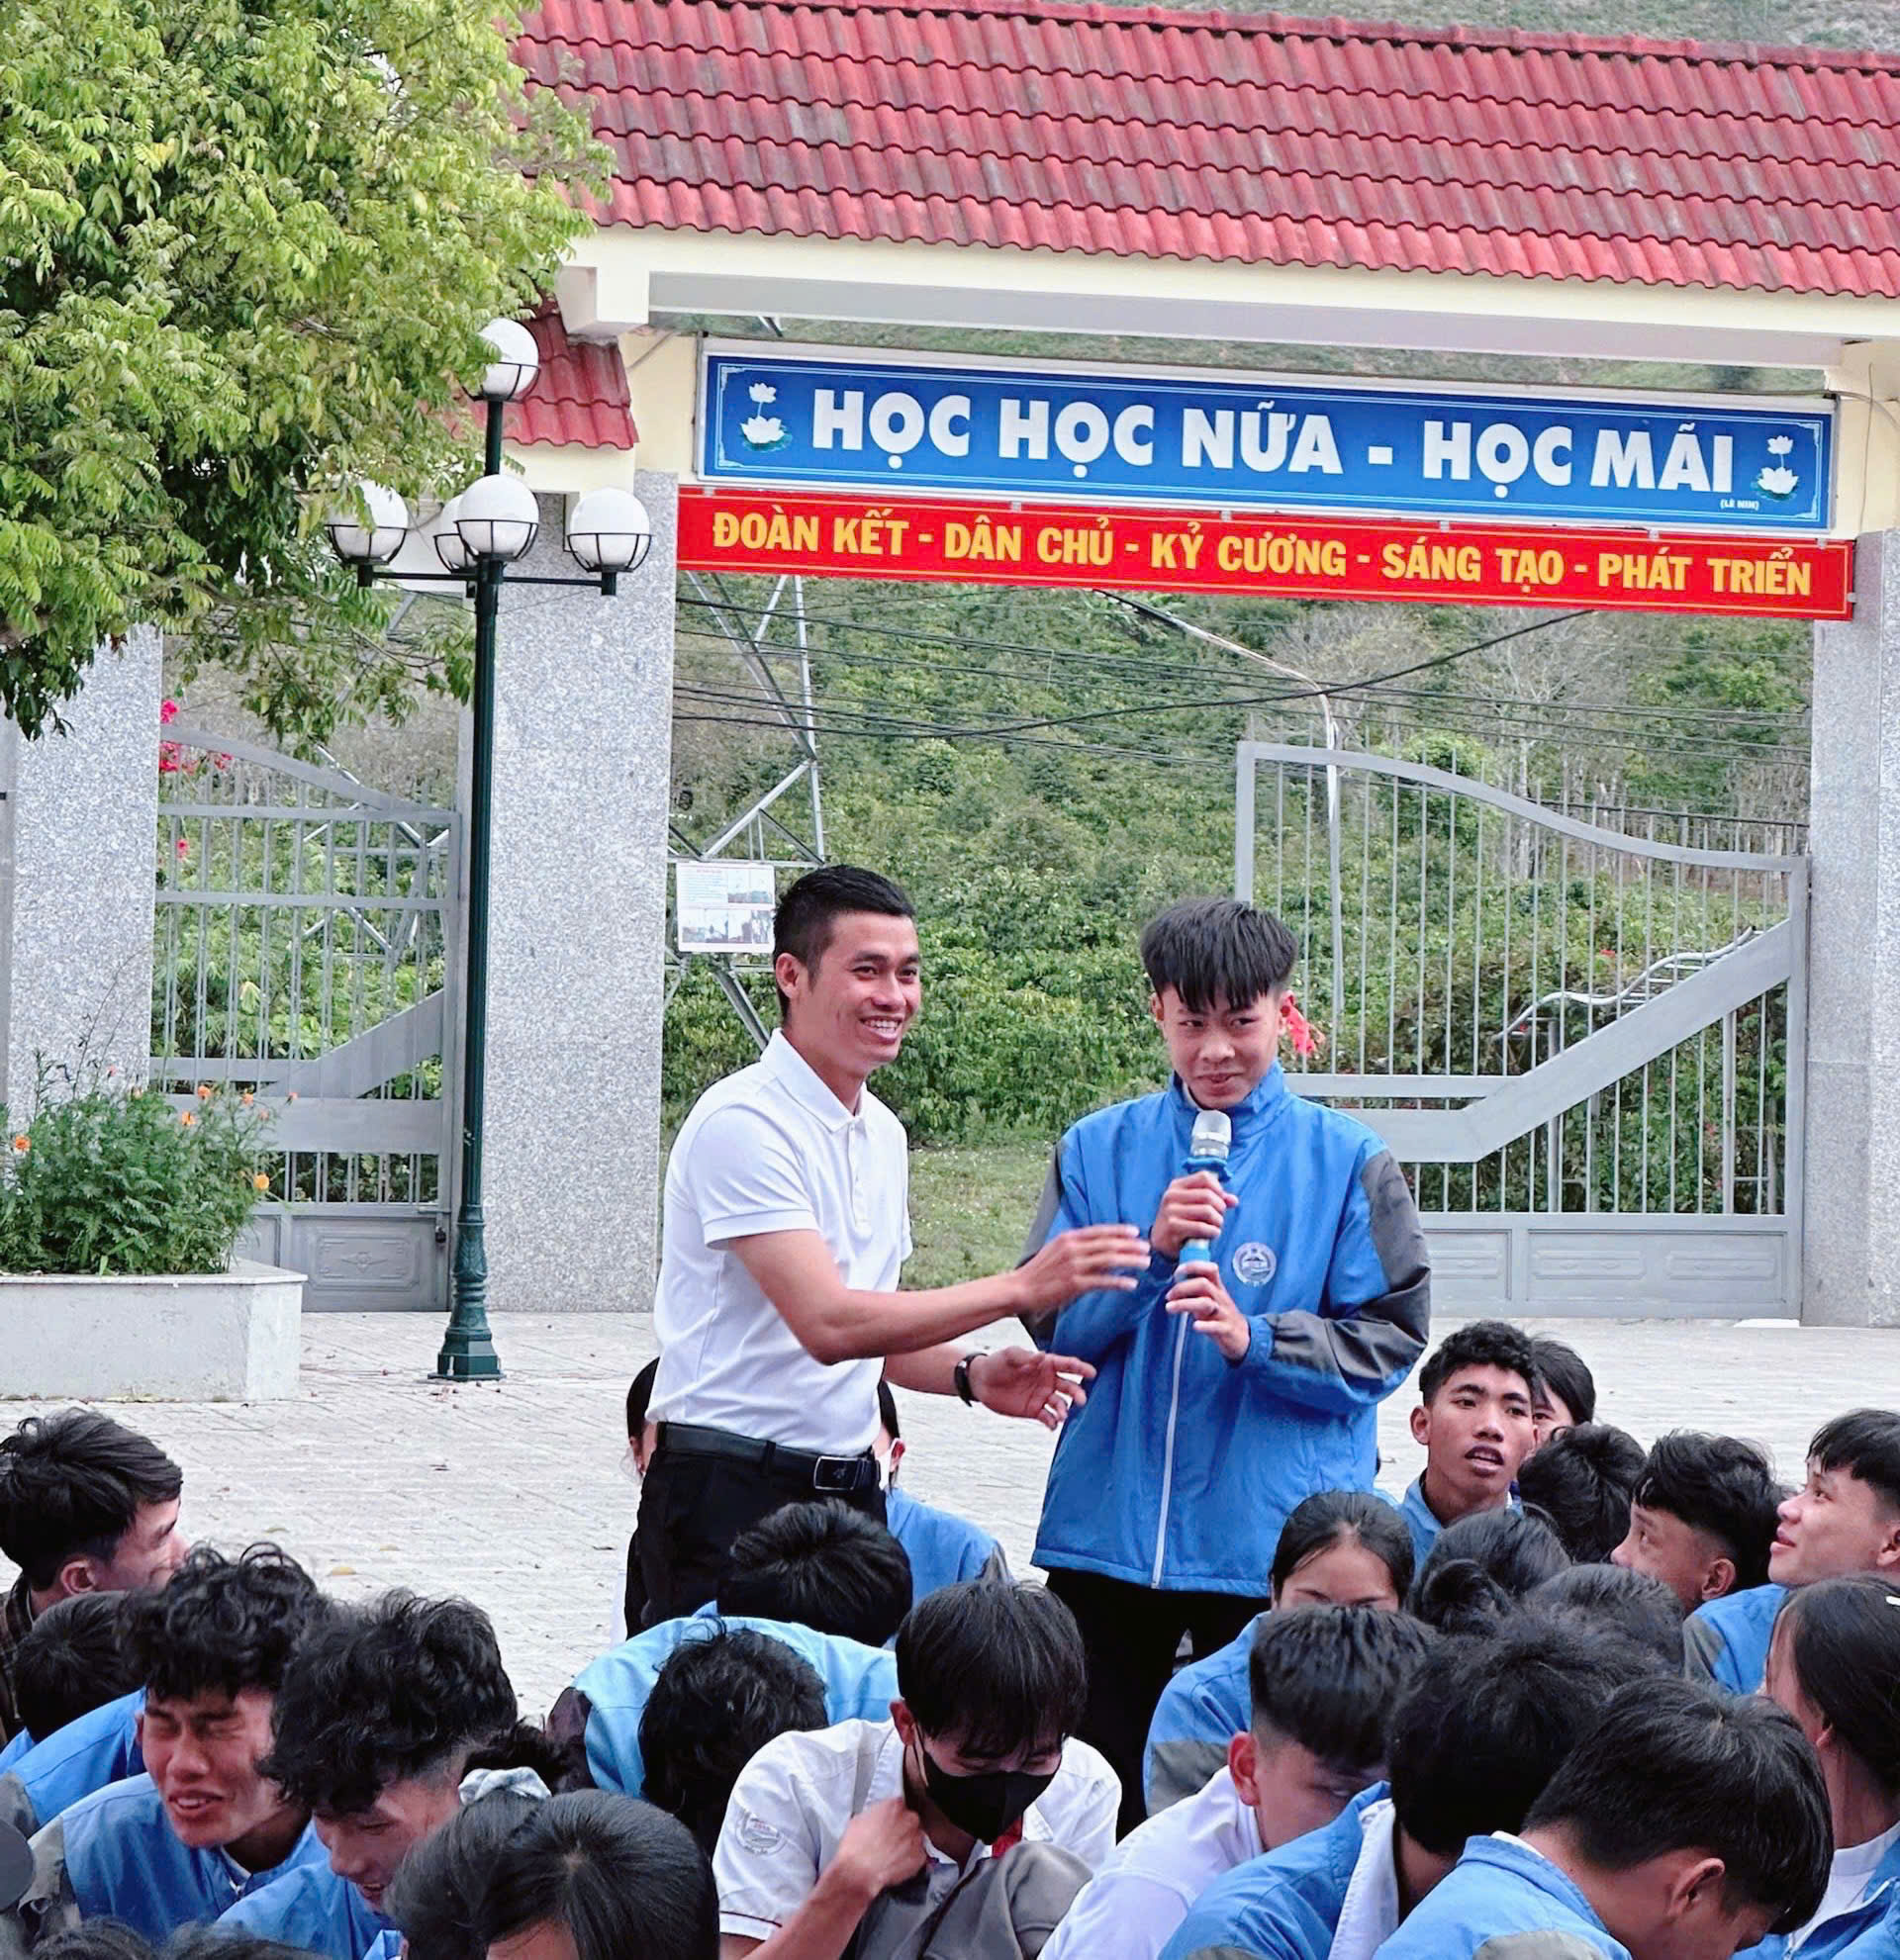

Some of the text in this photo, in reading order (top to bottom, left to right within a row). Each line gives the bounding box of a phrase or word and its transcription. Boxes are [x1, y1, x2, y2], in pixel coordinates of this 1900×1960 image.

[812, 389, 971, 469] HỌC
[998, 399, 1155, 478] HỌC
[1182, 400, 1344, 474] NỮA
[1423, 420, 1572, 499] HỌC
[1590, 422, 1733, 493] MÃI
[712, 505, 819, 553] ĐOÀN
[833, 508, 909, 556] KẾT
[944, 513, 1022, 562] DÂN
[1036, 516, 1113, 566] CHỦ
[1151, 521, 1204, 570] KỶ
[1217, 530, 1347, 577] CƯƠNG
[1381, 535, 1481, 583] SÁNG
[1494, 547, 1565, 594] TẠO
[1598, 546, 1693, 592] PHÁT
[1706, 546, 1812, 597] TRIỂN
